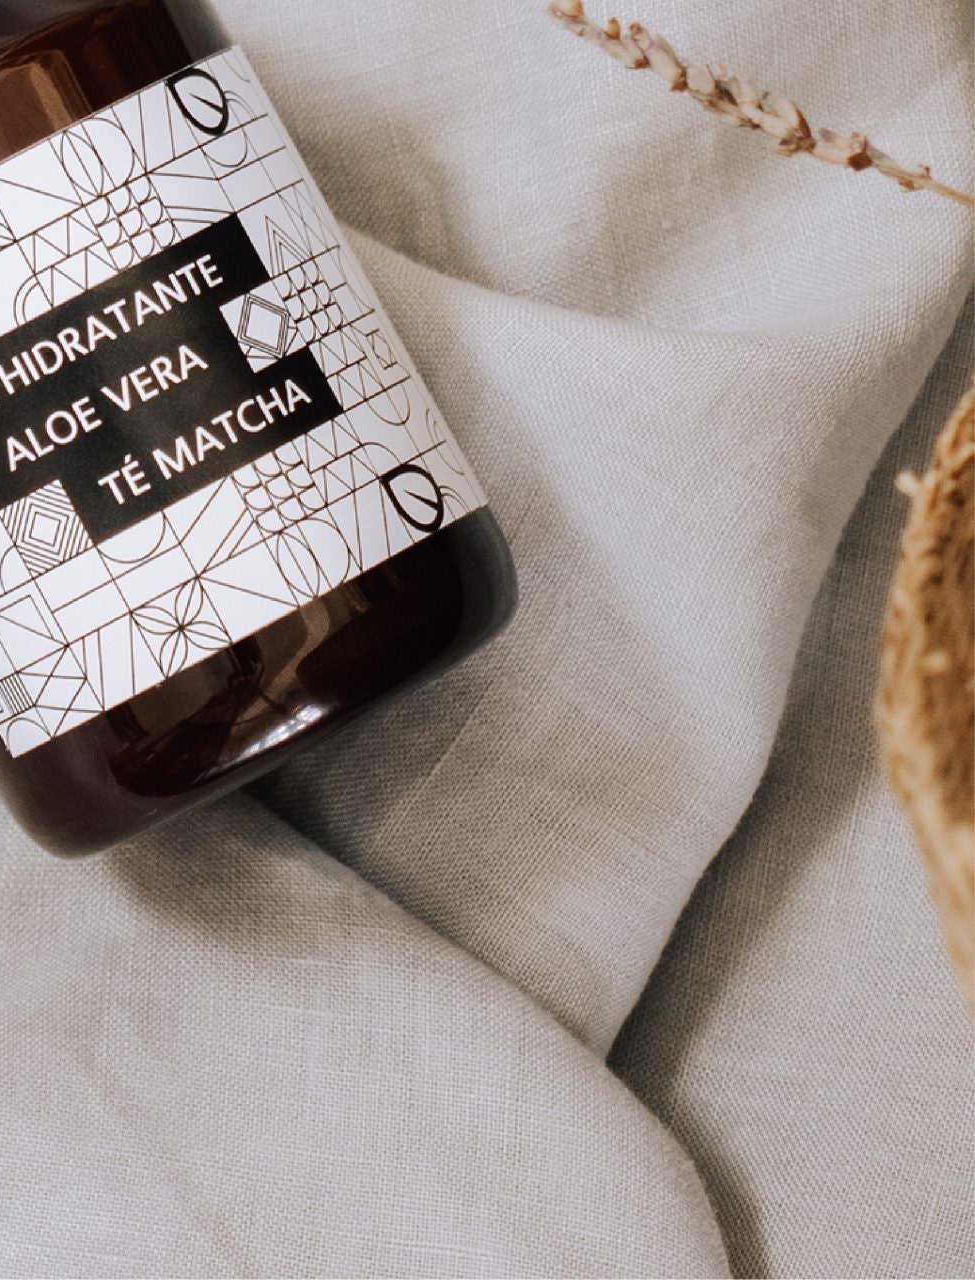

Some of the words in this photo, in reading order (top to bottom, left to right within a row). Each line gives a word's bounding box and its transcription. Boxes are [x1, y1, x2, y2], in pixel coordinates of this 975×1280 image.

[6, 397, 103, 472] ALOE
[101, 345, 209, 412] VERA
[98, 454, 152, 505] TÉ
[152, 379, 312, 481] MATCHA
